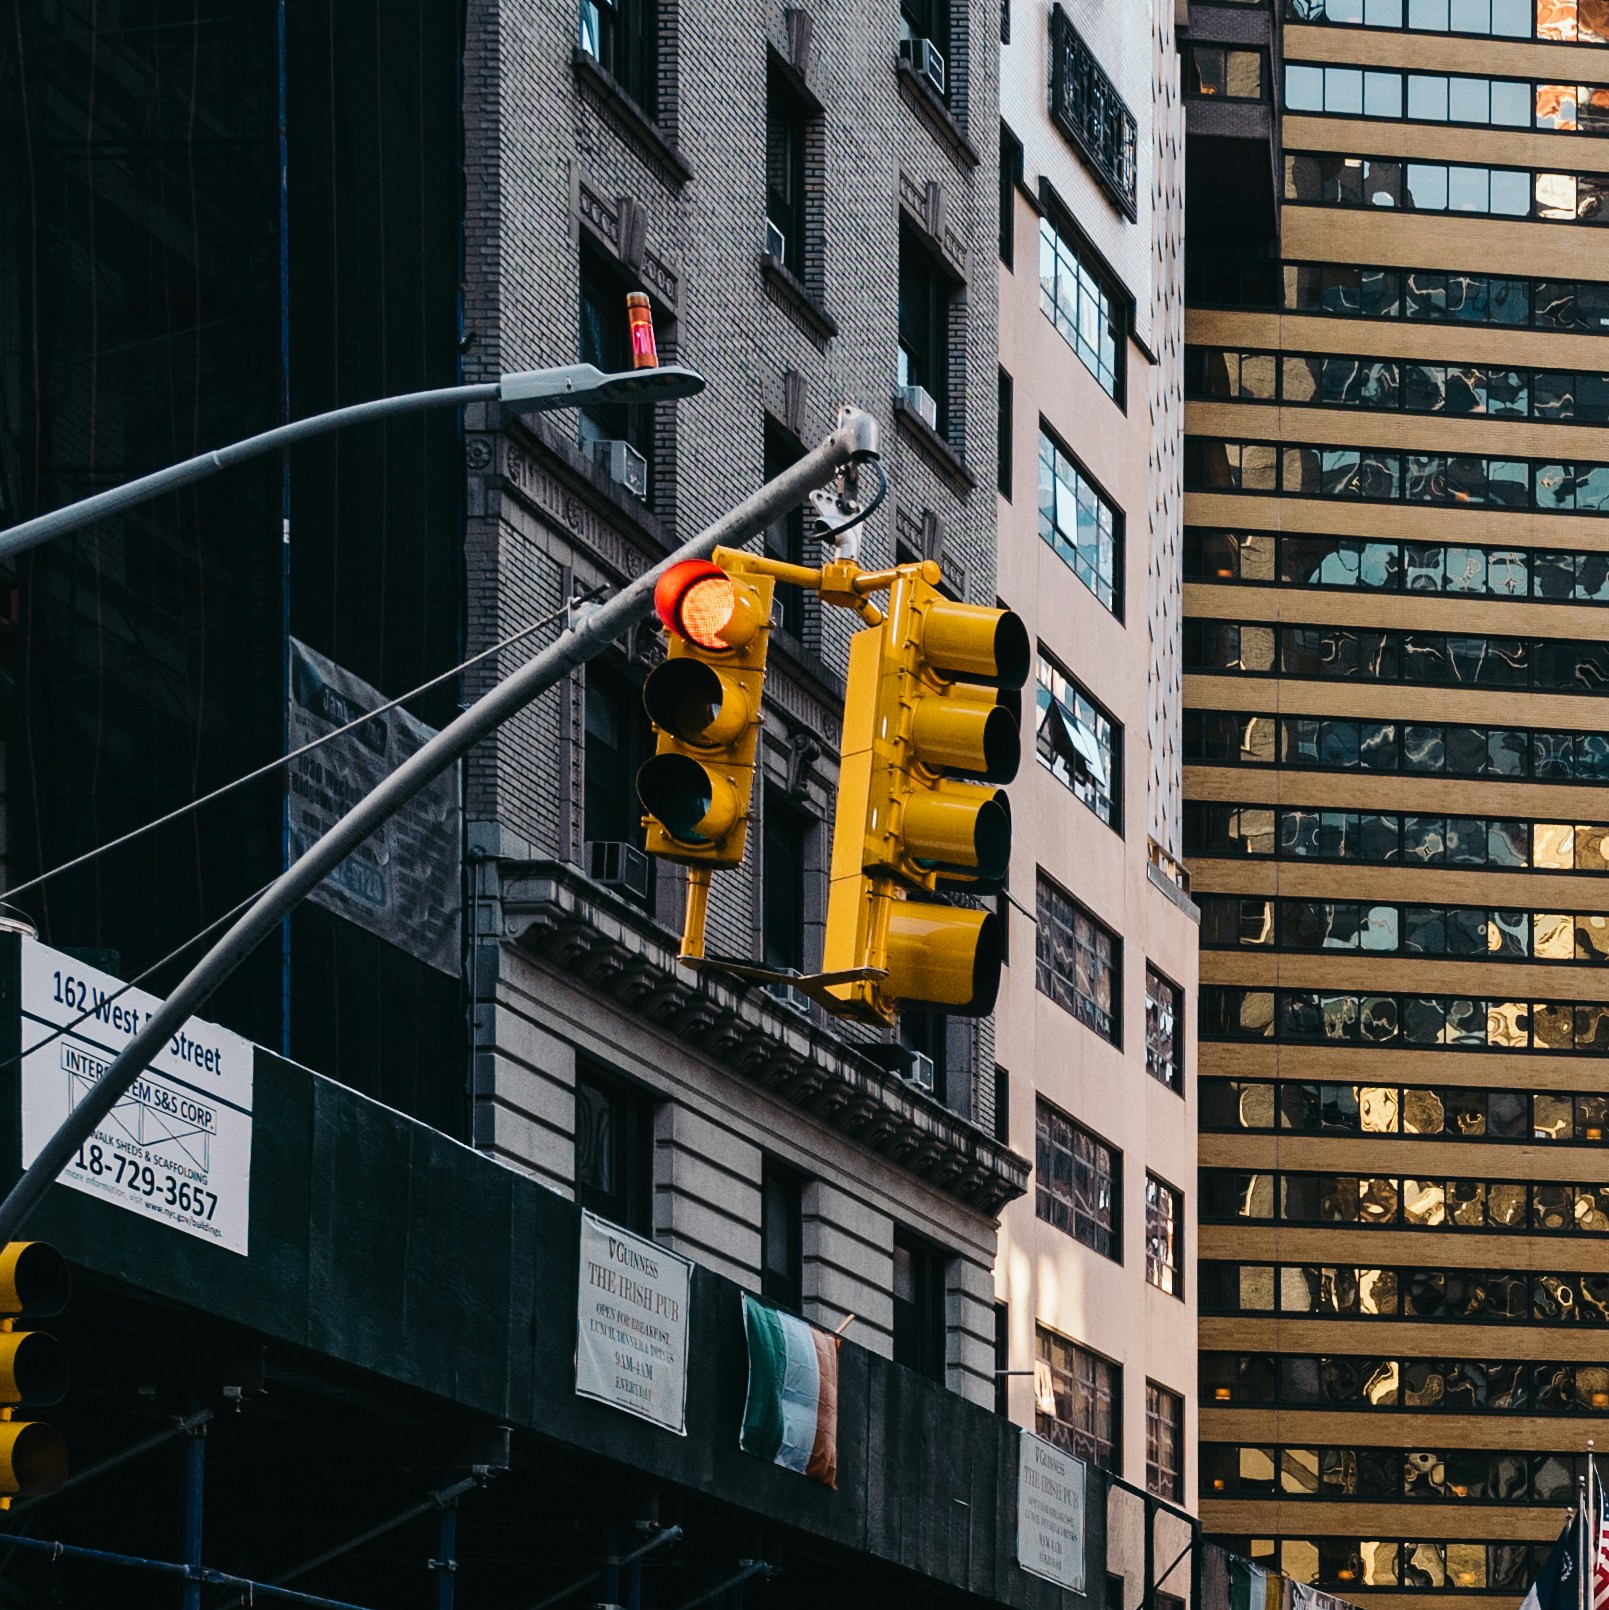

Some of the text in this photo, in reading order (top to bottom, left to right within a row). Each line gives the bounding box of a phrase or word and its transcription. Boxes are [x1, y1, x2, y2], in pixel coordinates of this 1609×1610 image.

[52, 970, 222, 1077] 162 West Street
[153, 1094, 179, 1119] S&S
[180, 1101, 215, 1131] CORP.
[73, 1143, 219, 1222] 18-729-3657
[115, 1138, 209, 1186] SHEDS & SCAFFOLDING
[616, 1241, 659, 1279] GUINNESS
[587, 1261, 680, 1323] THE IRISH PUB
[596, 1302, 616, 1322] OPEN
[616, 1375, 653, 1401] EVERYDAY
[1024, 1464, 1080, 1509] THE IRISH PUB
